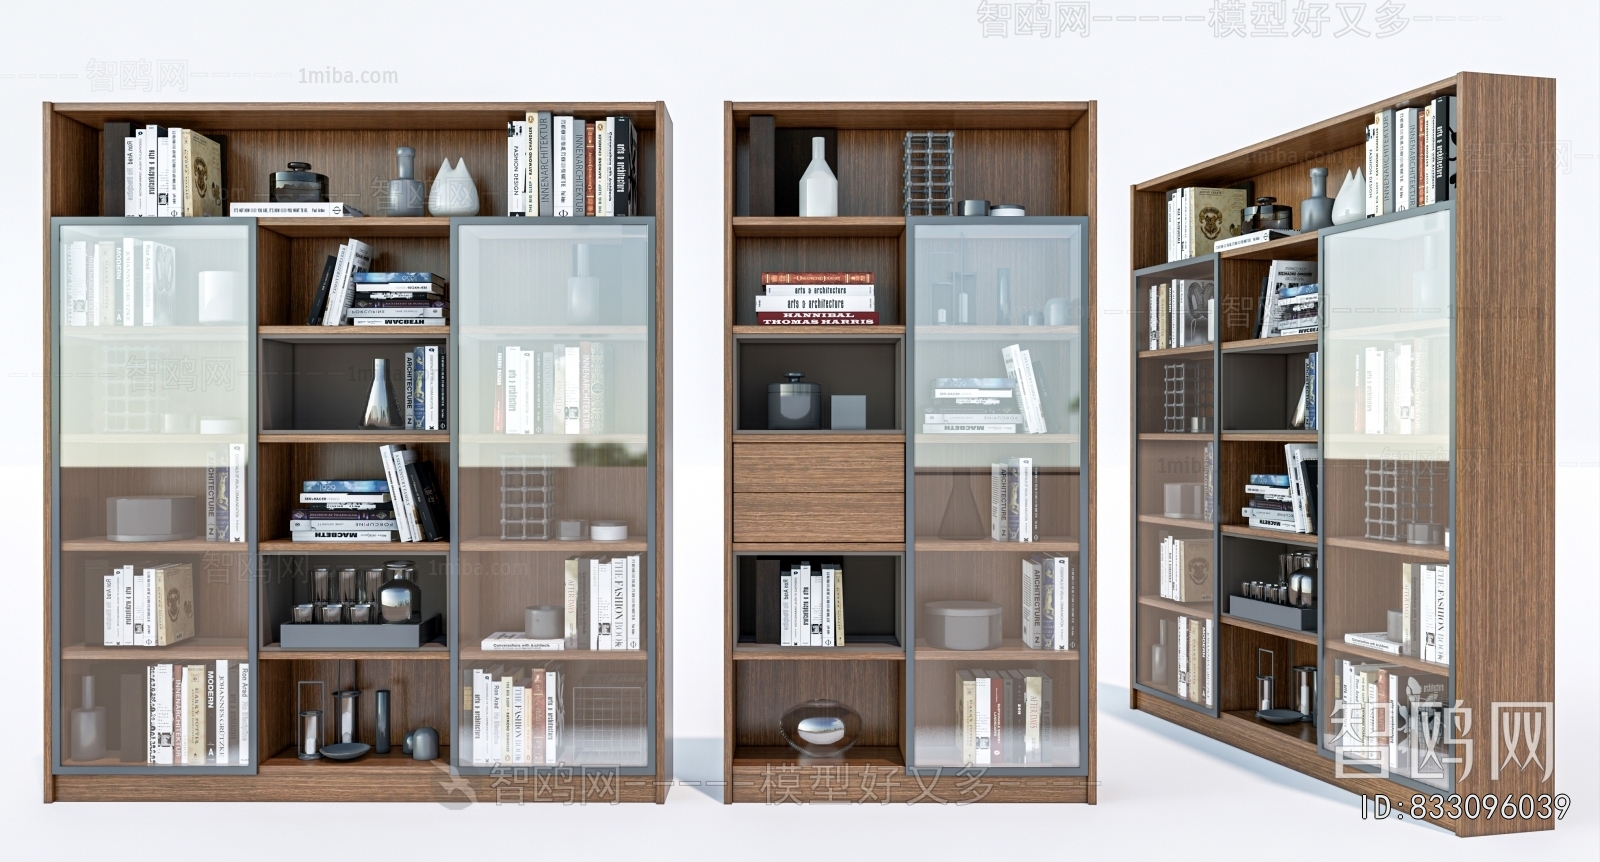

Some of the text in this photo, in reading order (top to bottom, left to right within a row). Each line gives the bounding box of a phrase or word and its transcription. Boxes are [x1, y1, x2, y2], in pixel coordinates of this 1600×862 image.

[540, 118, 549, 203] INNENARCHITEKTUR
[617, 144, 626, 192] arts architecture
[788, 298, 844, 308] arts architecture
[509, 385, 517, 411] architecture
[615, 560, 623, 647] THE FASHION BOOK
[1424, 683, 1444, 692] architecture
